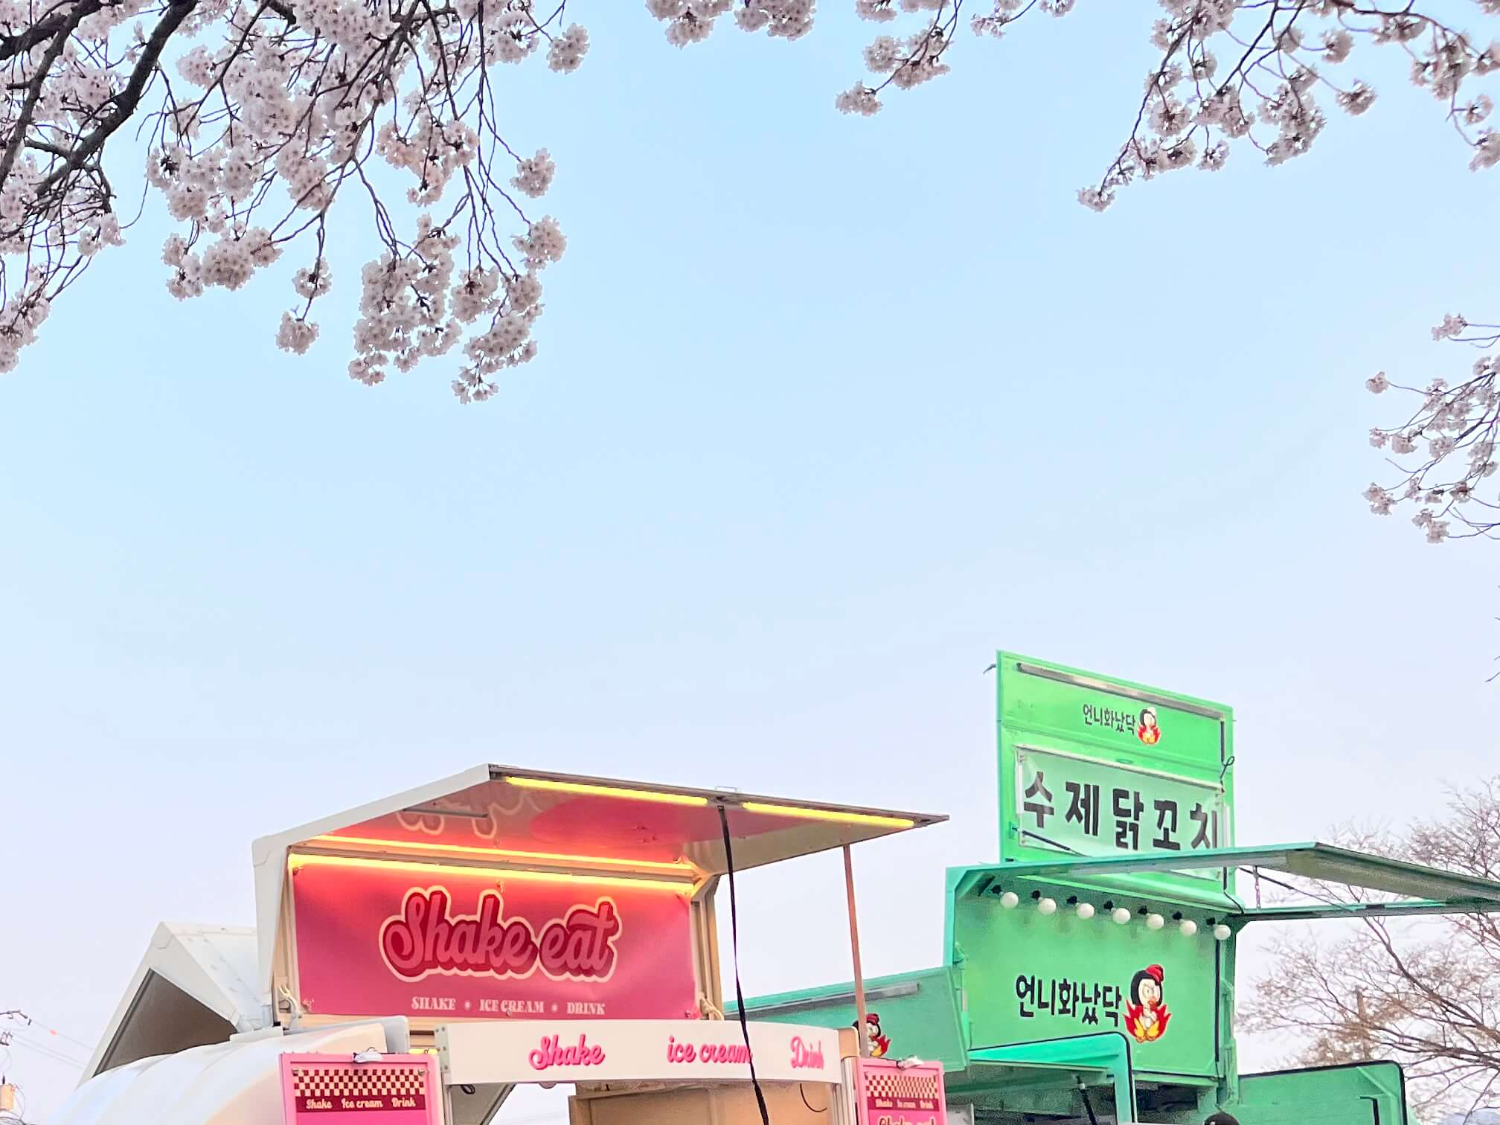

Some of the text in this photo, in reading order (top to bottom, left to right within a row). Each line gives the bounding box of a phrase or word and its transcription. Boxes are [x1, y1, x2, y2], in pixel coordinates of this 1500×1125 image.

[381, 887, 622, 982] Shake eat
[411, 996, 605, 1015] SHAKE ICE CREAM DRINK
[529, 1034, 824, 1070] Shake ice cream Drink
[306, 1098, 333, 1110] Shake
[356, 1099, 383, 1108] cream
[391, 1097, 416, 1108] Drink
